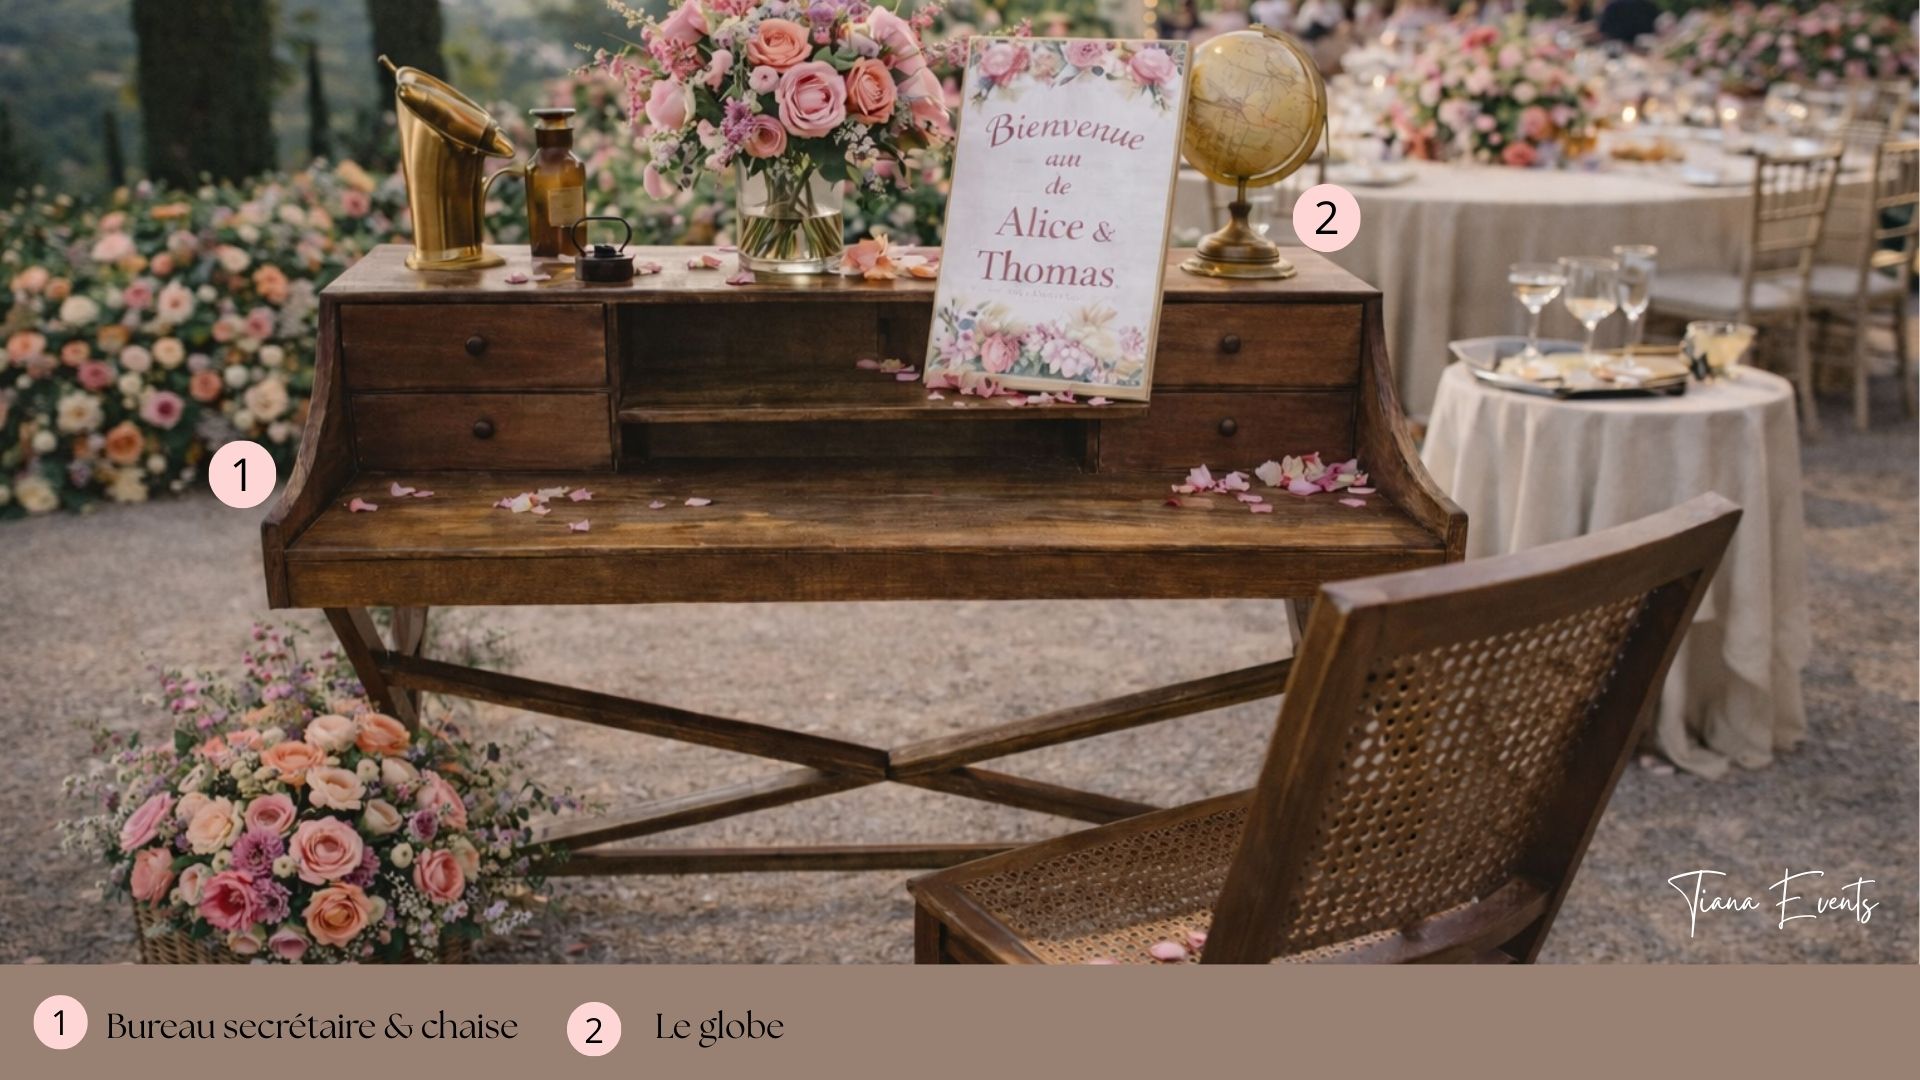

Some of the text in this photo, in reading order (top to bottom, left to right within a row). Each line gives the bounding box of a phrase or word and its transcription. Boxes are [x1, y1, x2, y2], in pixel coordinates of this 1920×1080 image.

[985, 113, 1145, 150] Bienvenue
[1045, 175, 1072, 195] de
[995, 206, 1116, 243] Alice &
